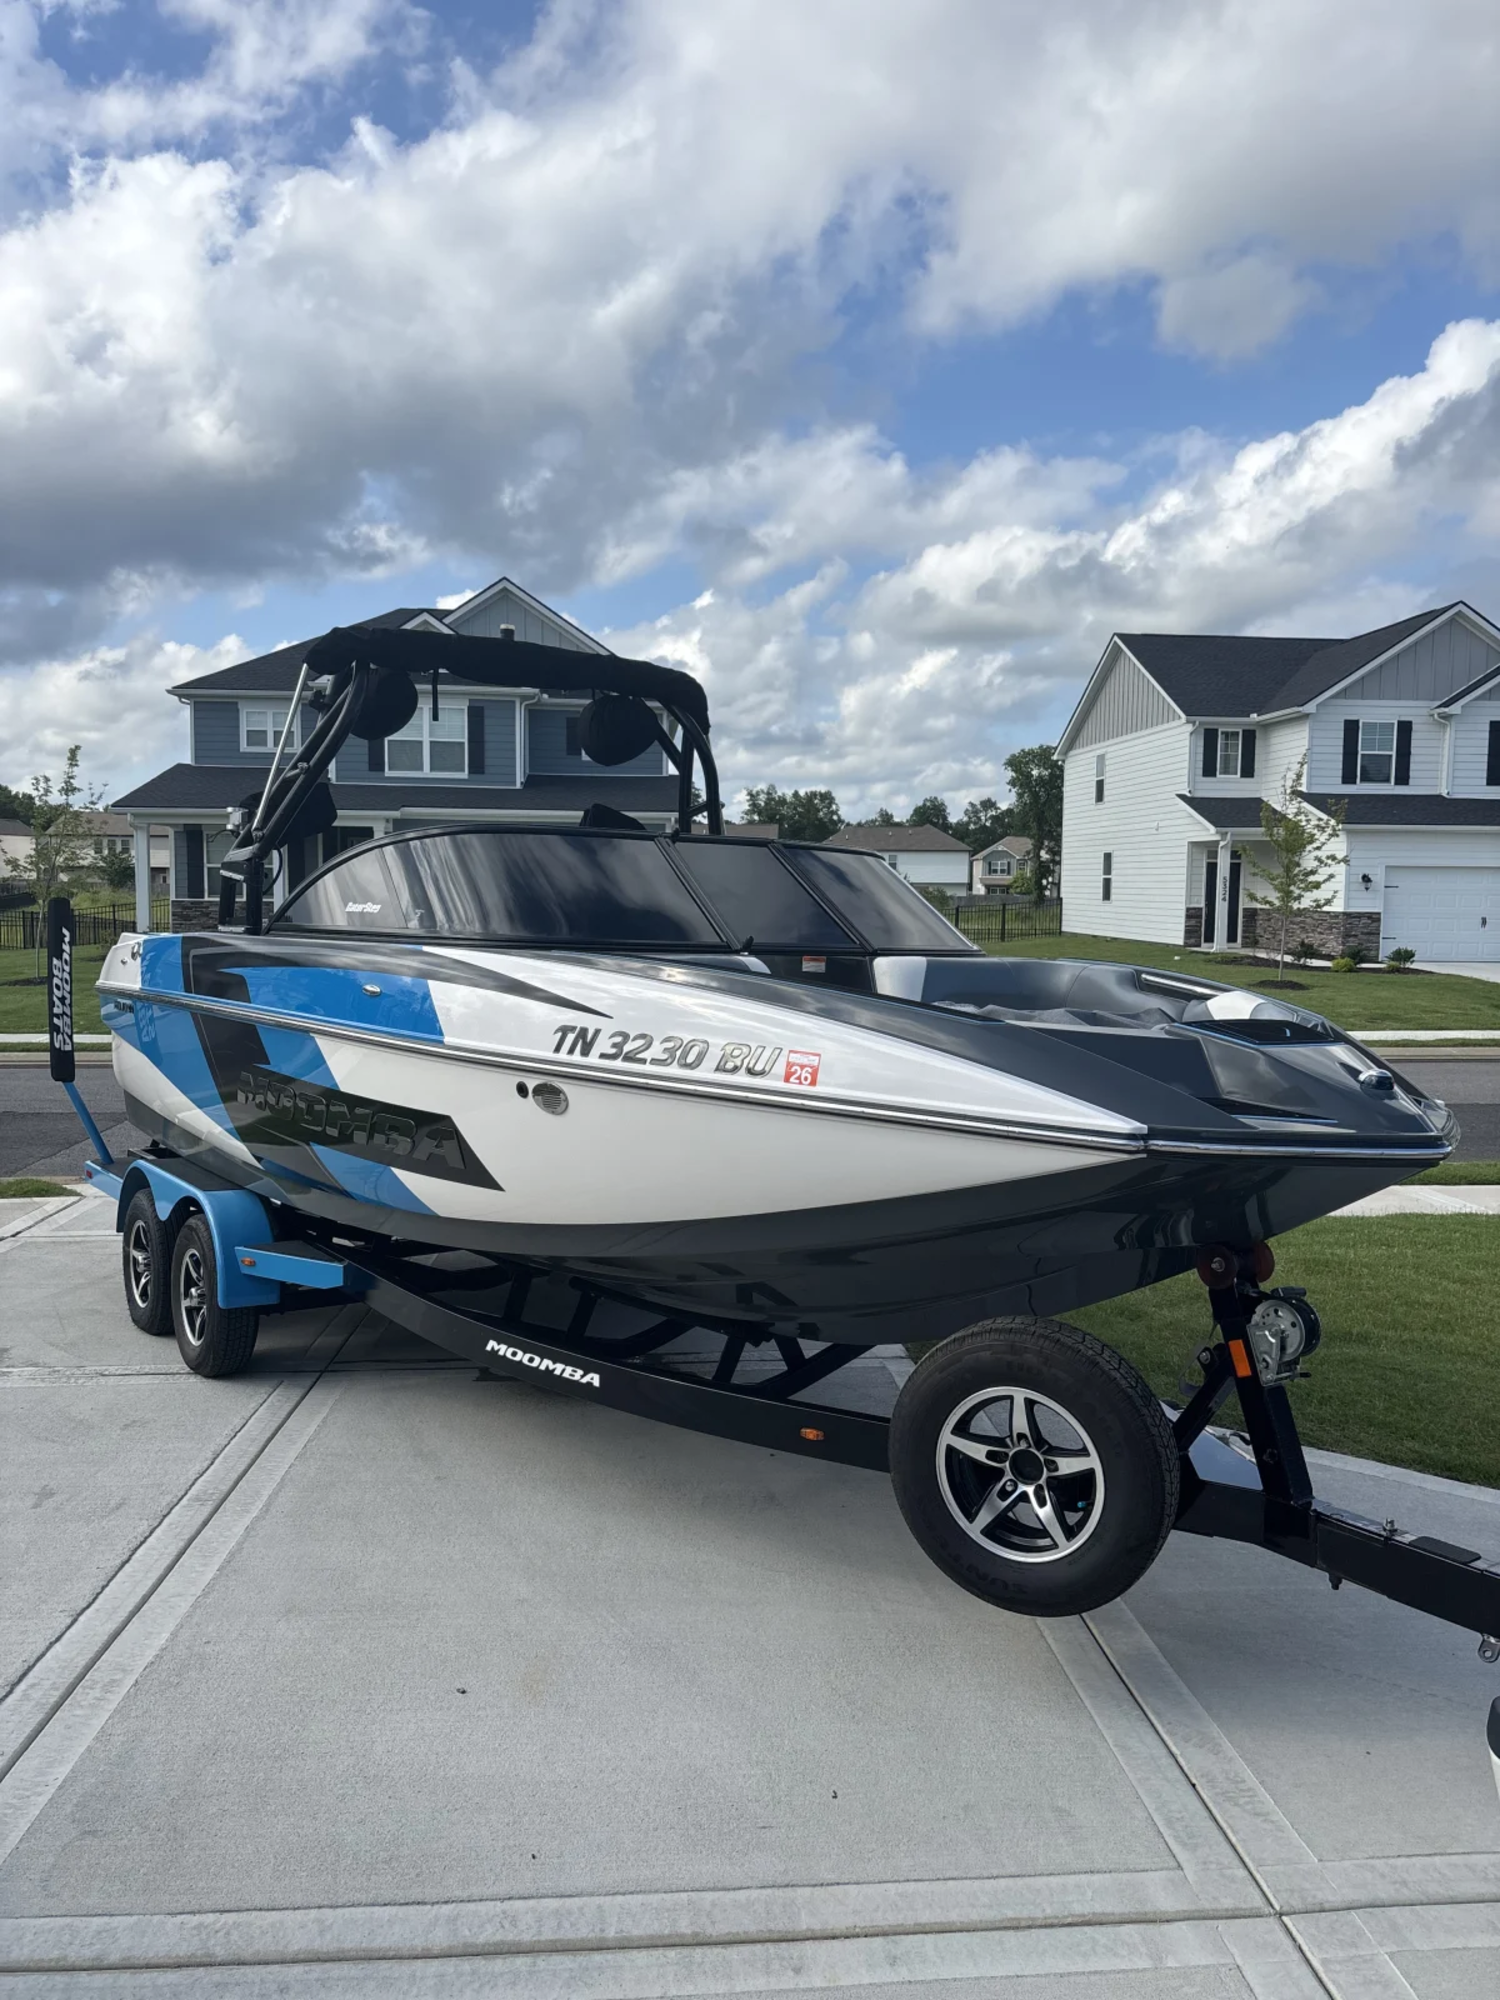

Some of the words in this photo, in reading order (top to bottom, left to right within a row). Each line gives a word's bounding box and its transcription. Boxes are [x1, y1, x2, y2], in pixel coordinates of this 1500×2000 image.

[52, 956, 63, 1051] BOATS
[61, 927, 72, 1051] MOOMBA
[552, 1024, 602, 1058] TN
[599, 1030, 710, 1071] 3230
[714, 1041, 783, 1079] BU
[789, 1065, 812, 1086] 26
[237, 1071, 466, 1170] MOOMBA
[485, 1339, 600, 1388] MOOMBA
